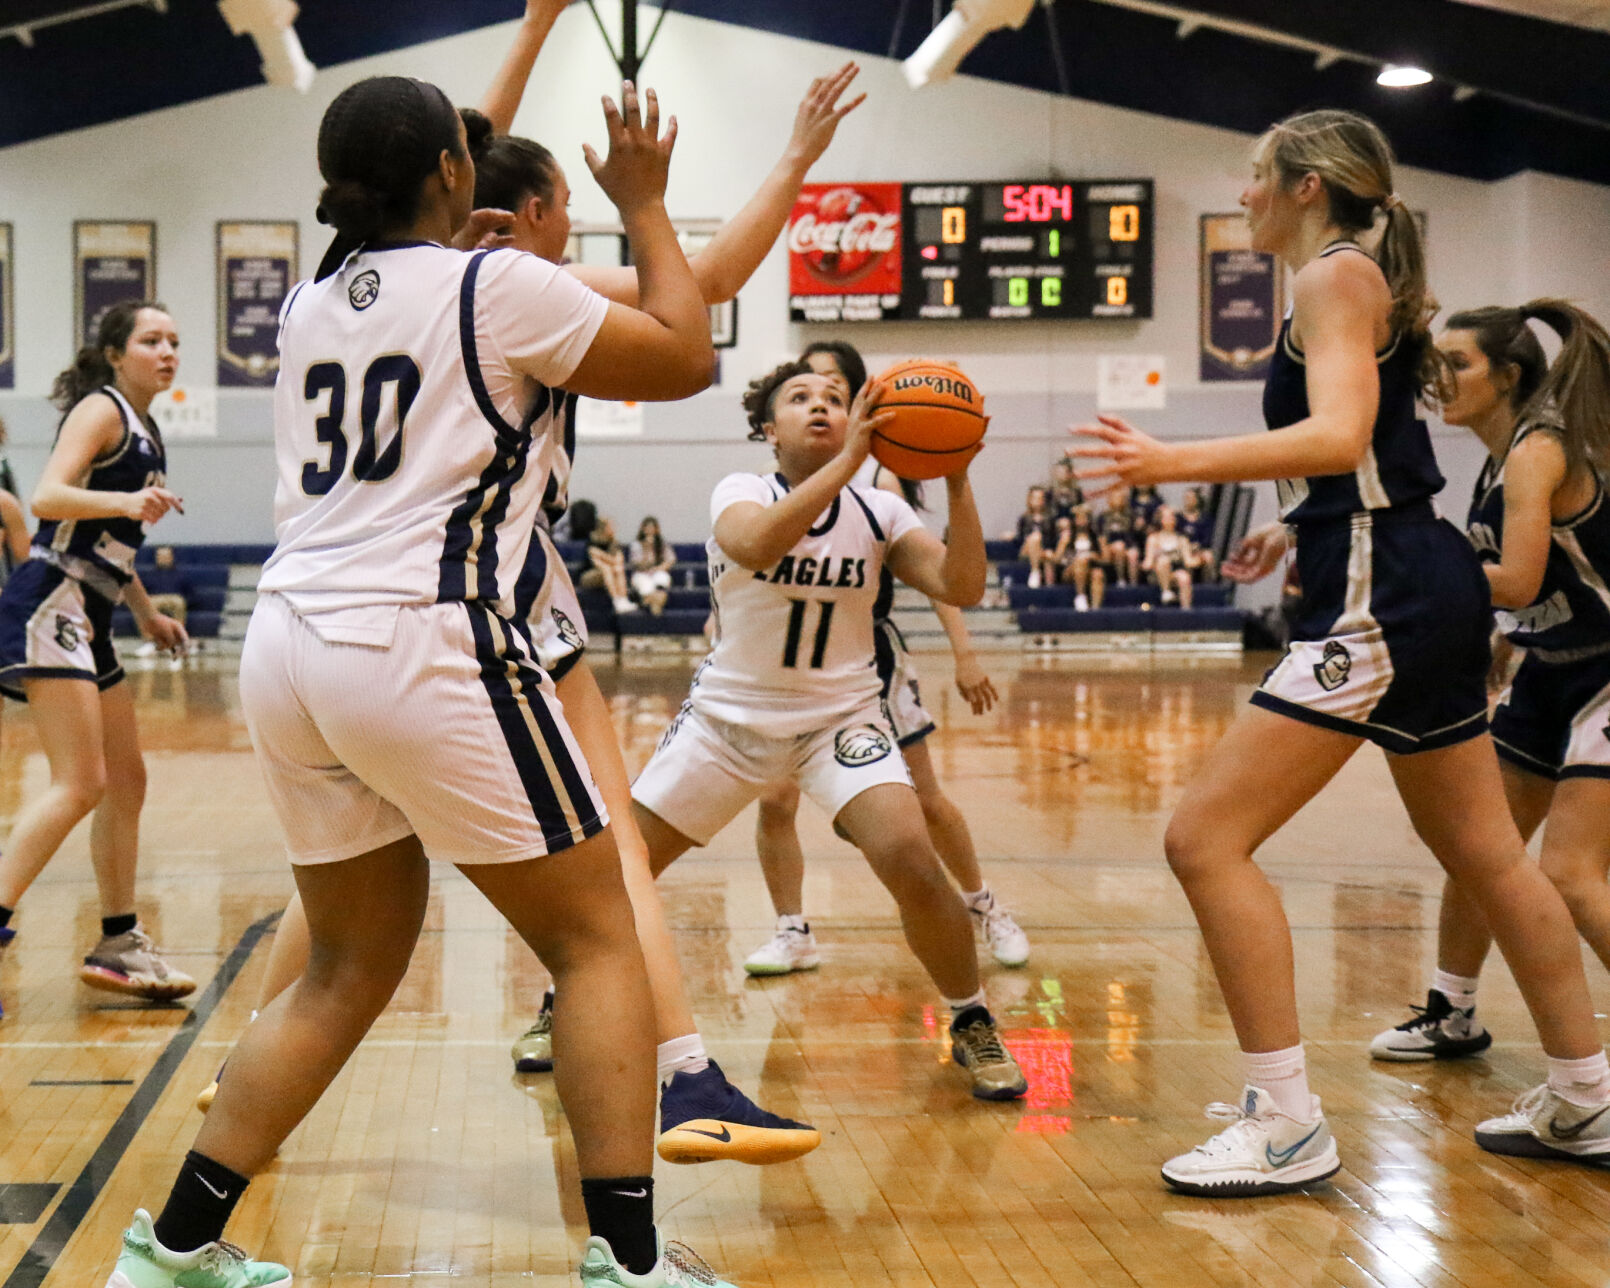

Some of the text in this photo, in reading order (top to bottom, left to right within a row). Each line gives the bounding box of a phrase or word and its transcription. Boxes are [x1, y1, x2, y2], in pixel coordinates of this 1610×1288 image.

[1002, 185, 1073, 222] 5:04
[941, 207, 966, 243] 0
[1049, 229, 1060, 258] 1
[943, 279, 954, 306] 1
[1106, 276, 1127, 306] 0
[894, 375, 973, 404] Wilson
[299, 350, 424, 499] 30
[753, 555, 866, 588] AGLES
[782, 597, 836, 669] 11
